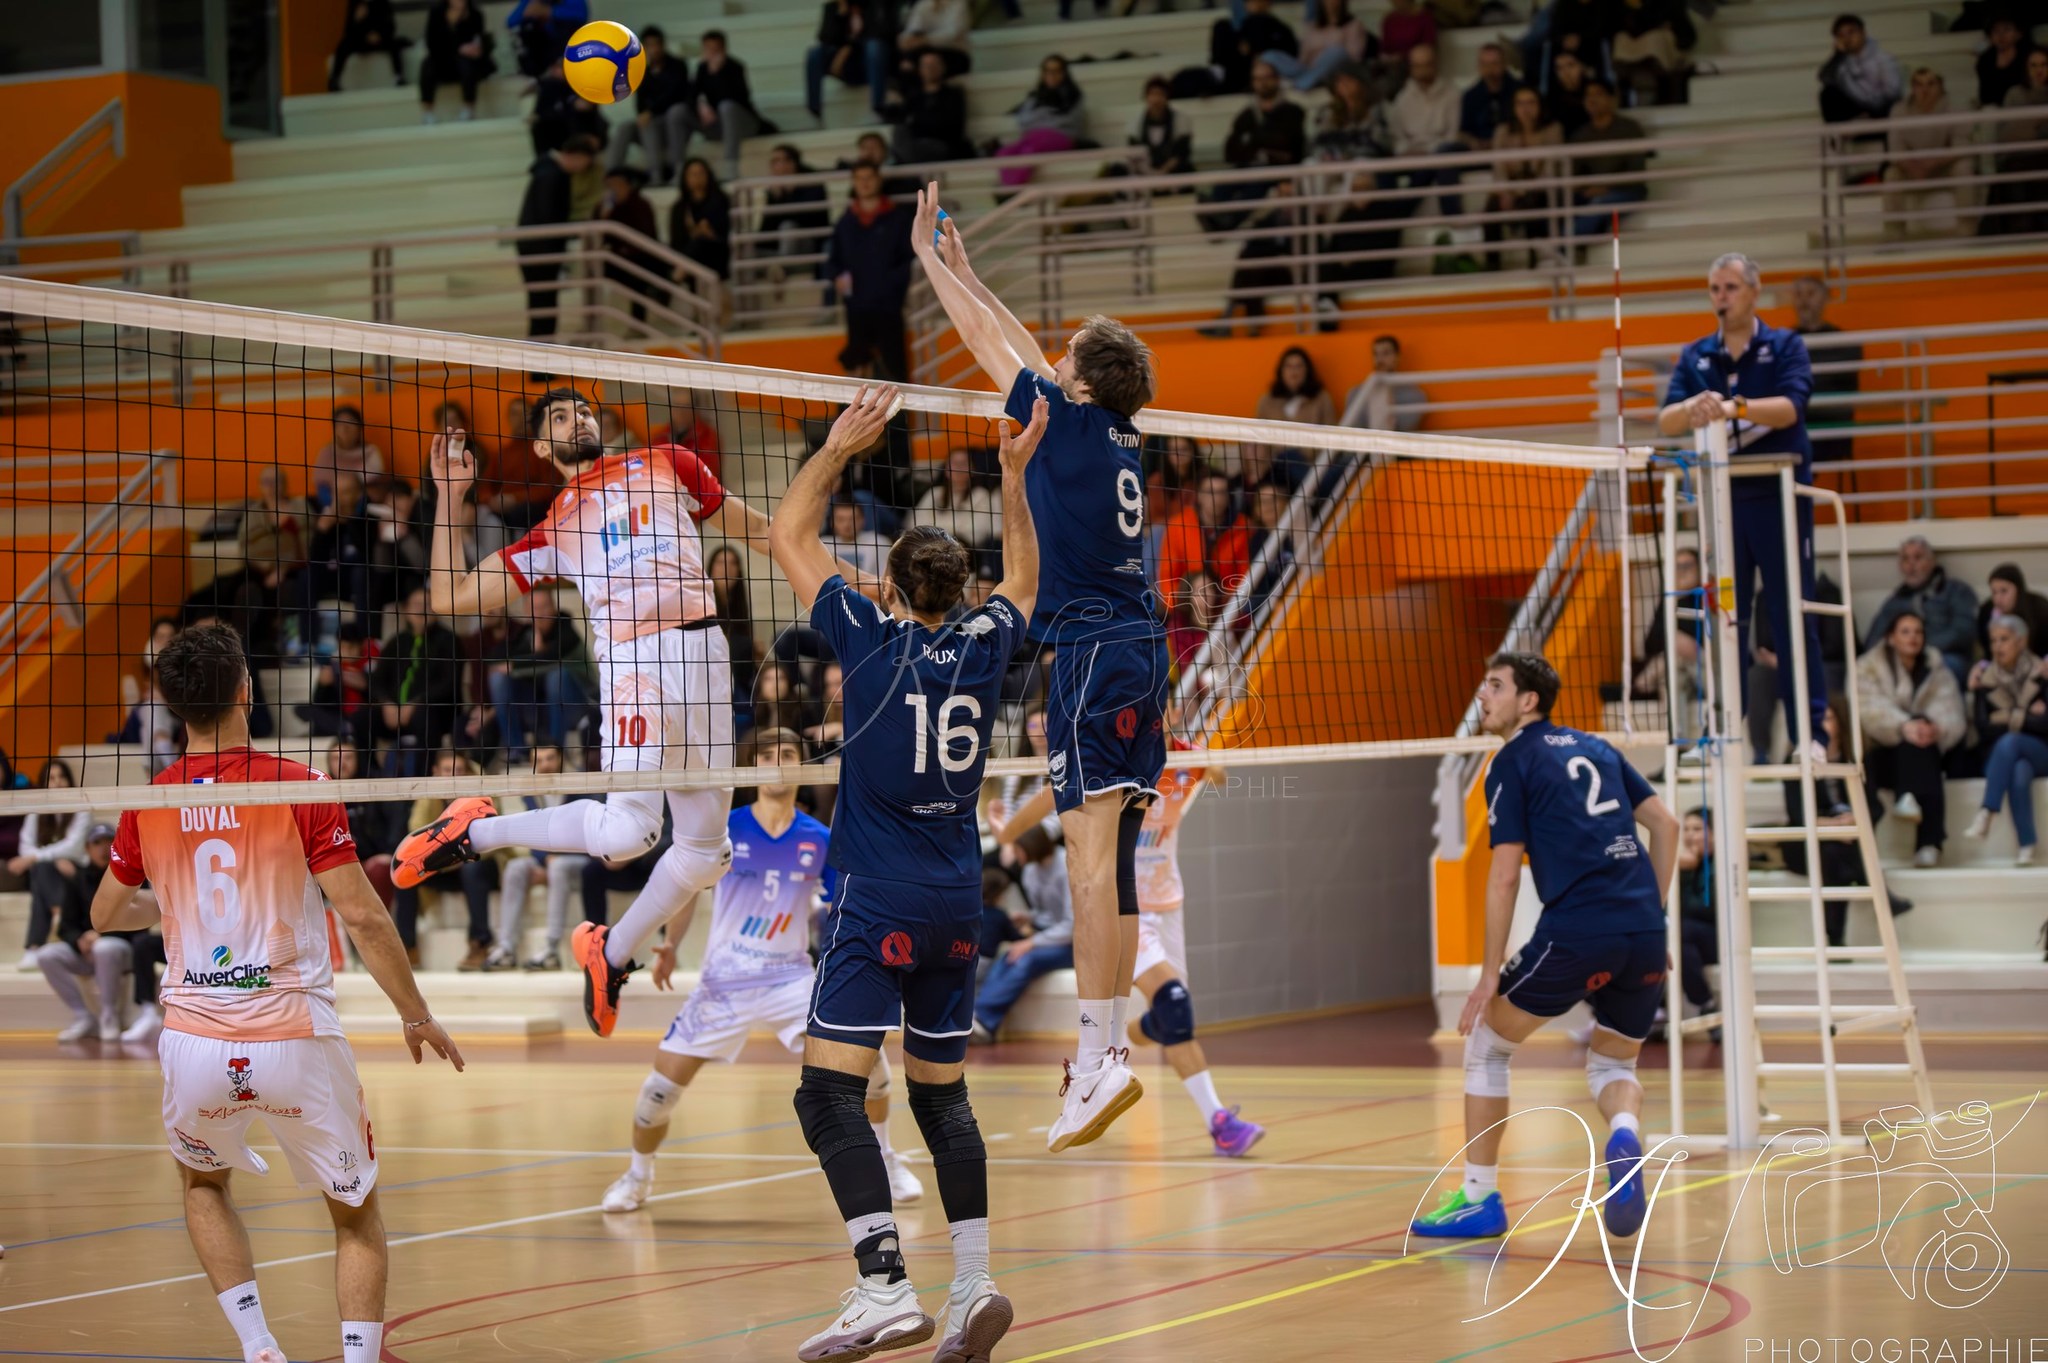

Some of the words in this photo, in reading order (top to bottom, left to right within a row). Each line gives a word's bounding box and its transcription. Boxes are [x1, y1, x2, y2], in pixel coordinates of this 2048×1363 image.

[1117, 468, 1143, 538] 9
[617, 714, 647, 747] 10
[905, 693, 982, 773] 16
[1567, 755, 1620, 816] 2
[180, 805, 241, 833] DUVAL
[194, 838, 242, 935] 6
[763, 869, 781, 902] 5
[182, 963, 272, 985] AuverClim
